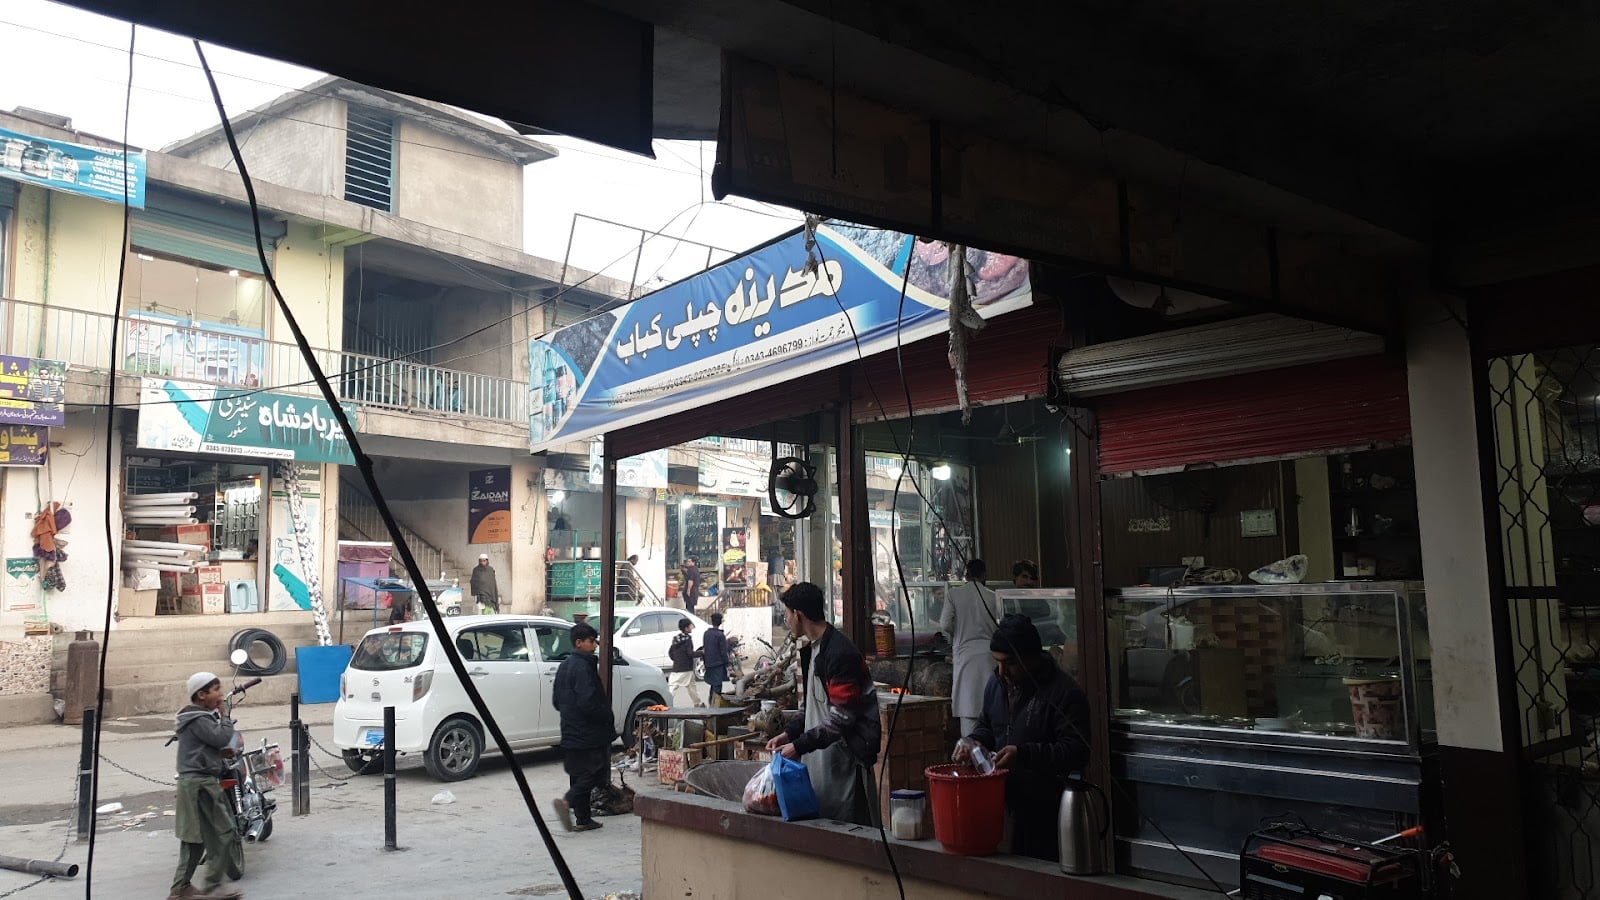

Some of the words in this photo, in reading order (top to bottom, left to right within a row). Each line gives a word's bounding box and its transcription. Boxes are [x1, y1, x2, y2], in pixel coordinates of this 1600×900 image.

[724, 259, 843, 338] مدینہ
[615, 313, 662, 365] کباب
[665, 301, 722, 348] چپلی
[471, 488, 509, 501] ZAIDAN
